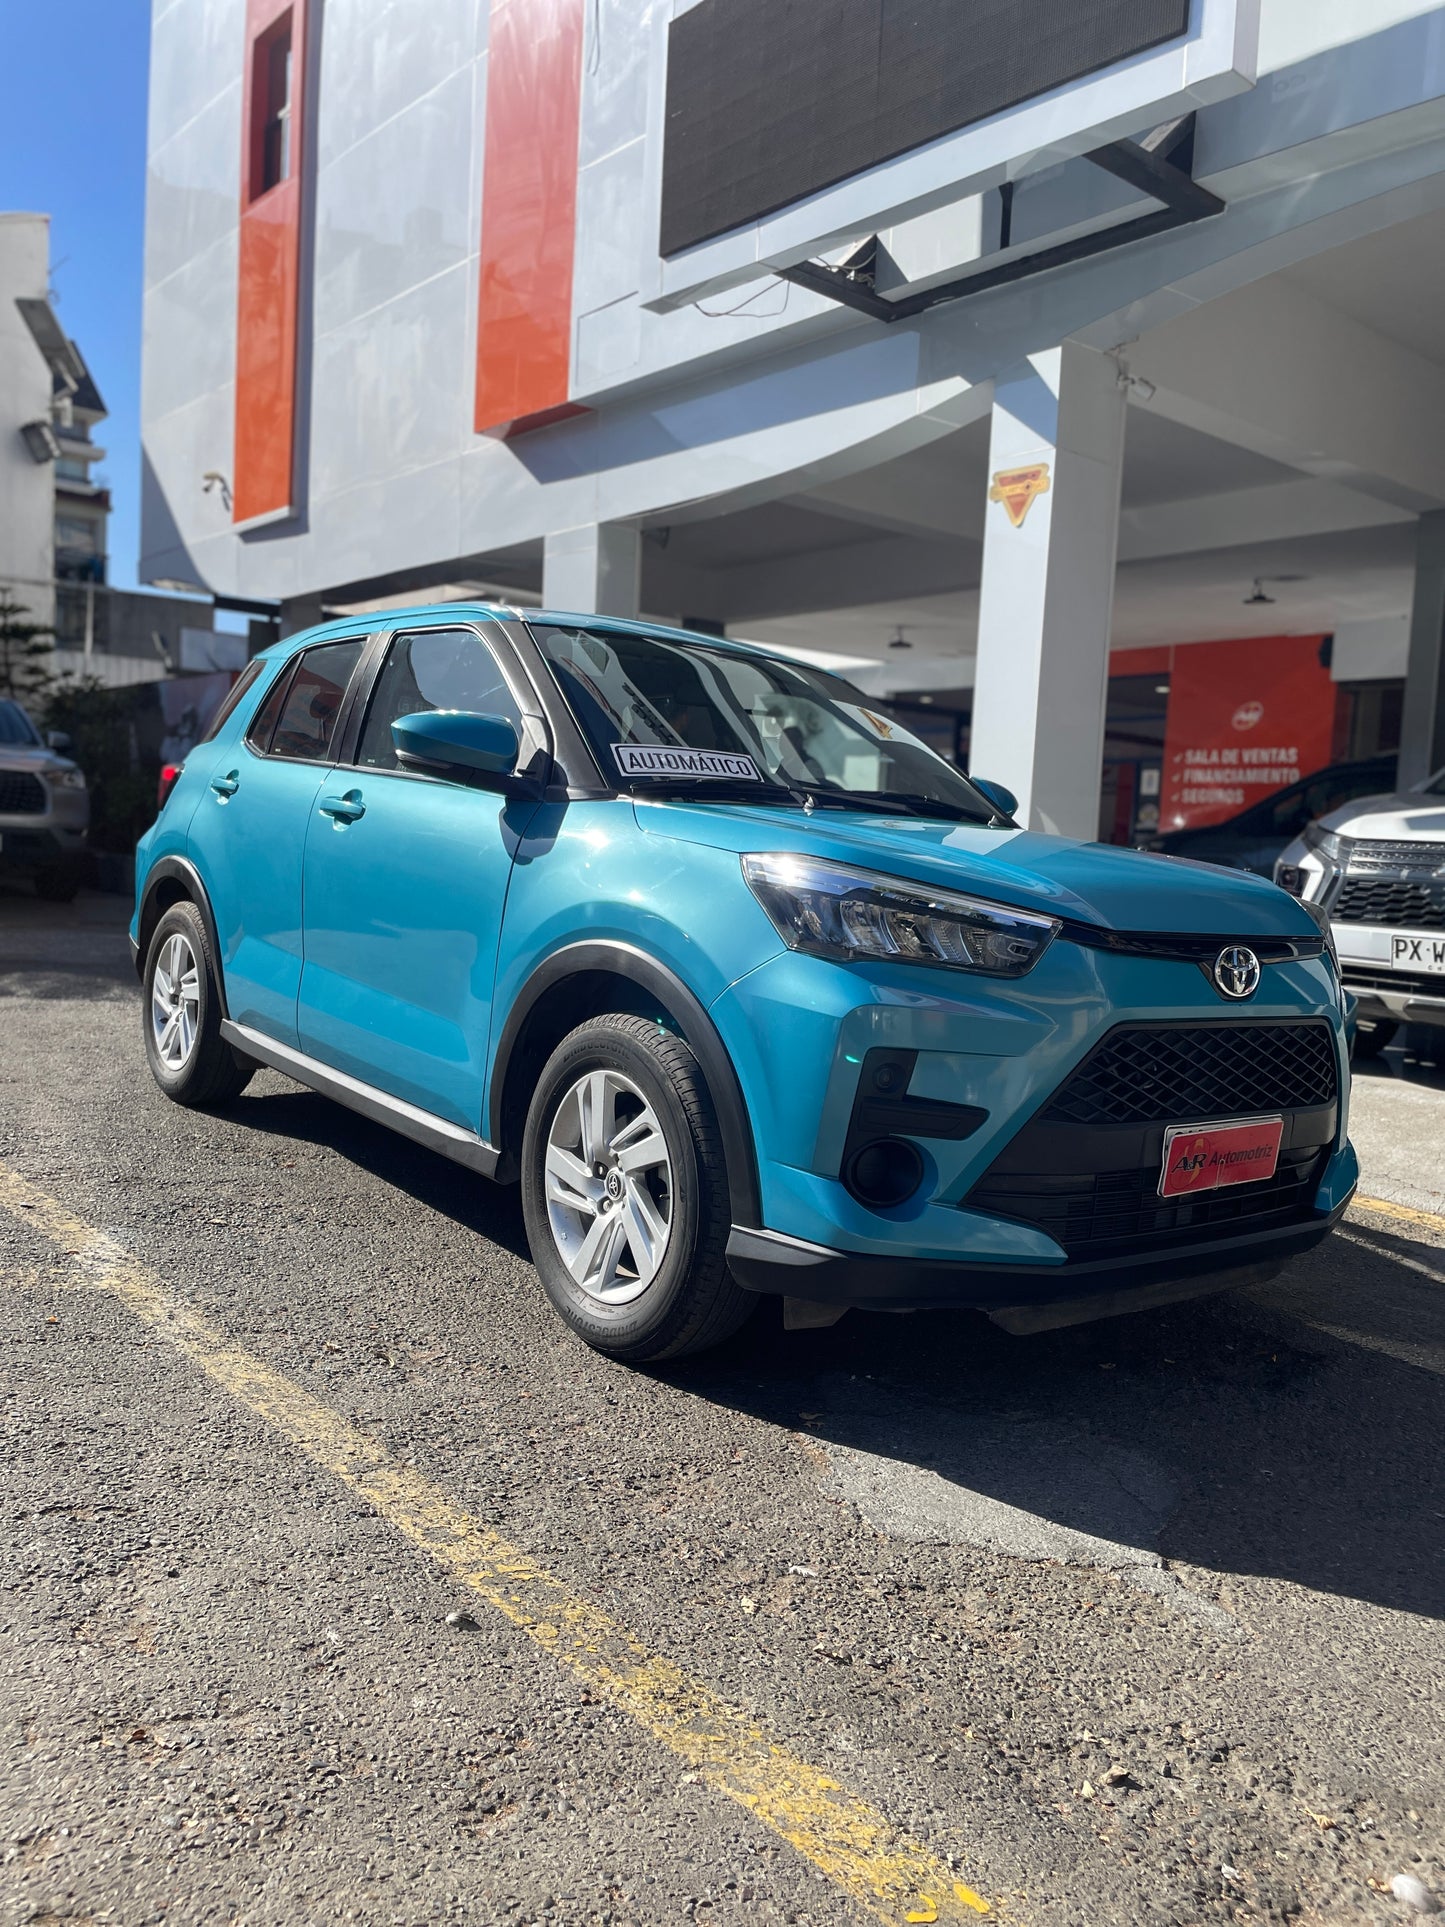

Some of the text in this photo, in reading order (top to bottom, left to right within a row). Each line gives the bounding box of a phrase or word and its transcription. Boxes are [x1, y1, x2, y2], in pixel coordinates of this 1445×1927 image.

[629, 752, 752, 776] AUTOMÁTICO
[1184, 747, 1298, 765] SALA DE VENTAS
[1182, 767, 1299, 783] FINANCIAMIENTO
[1181, 788, 1244, 804] SEGUROS
[1209, 1143, 1273, 1167] Automotriz
